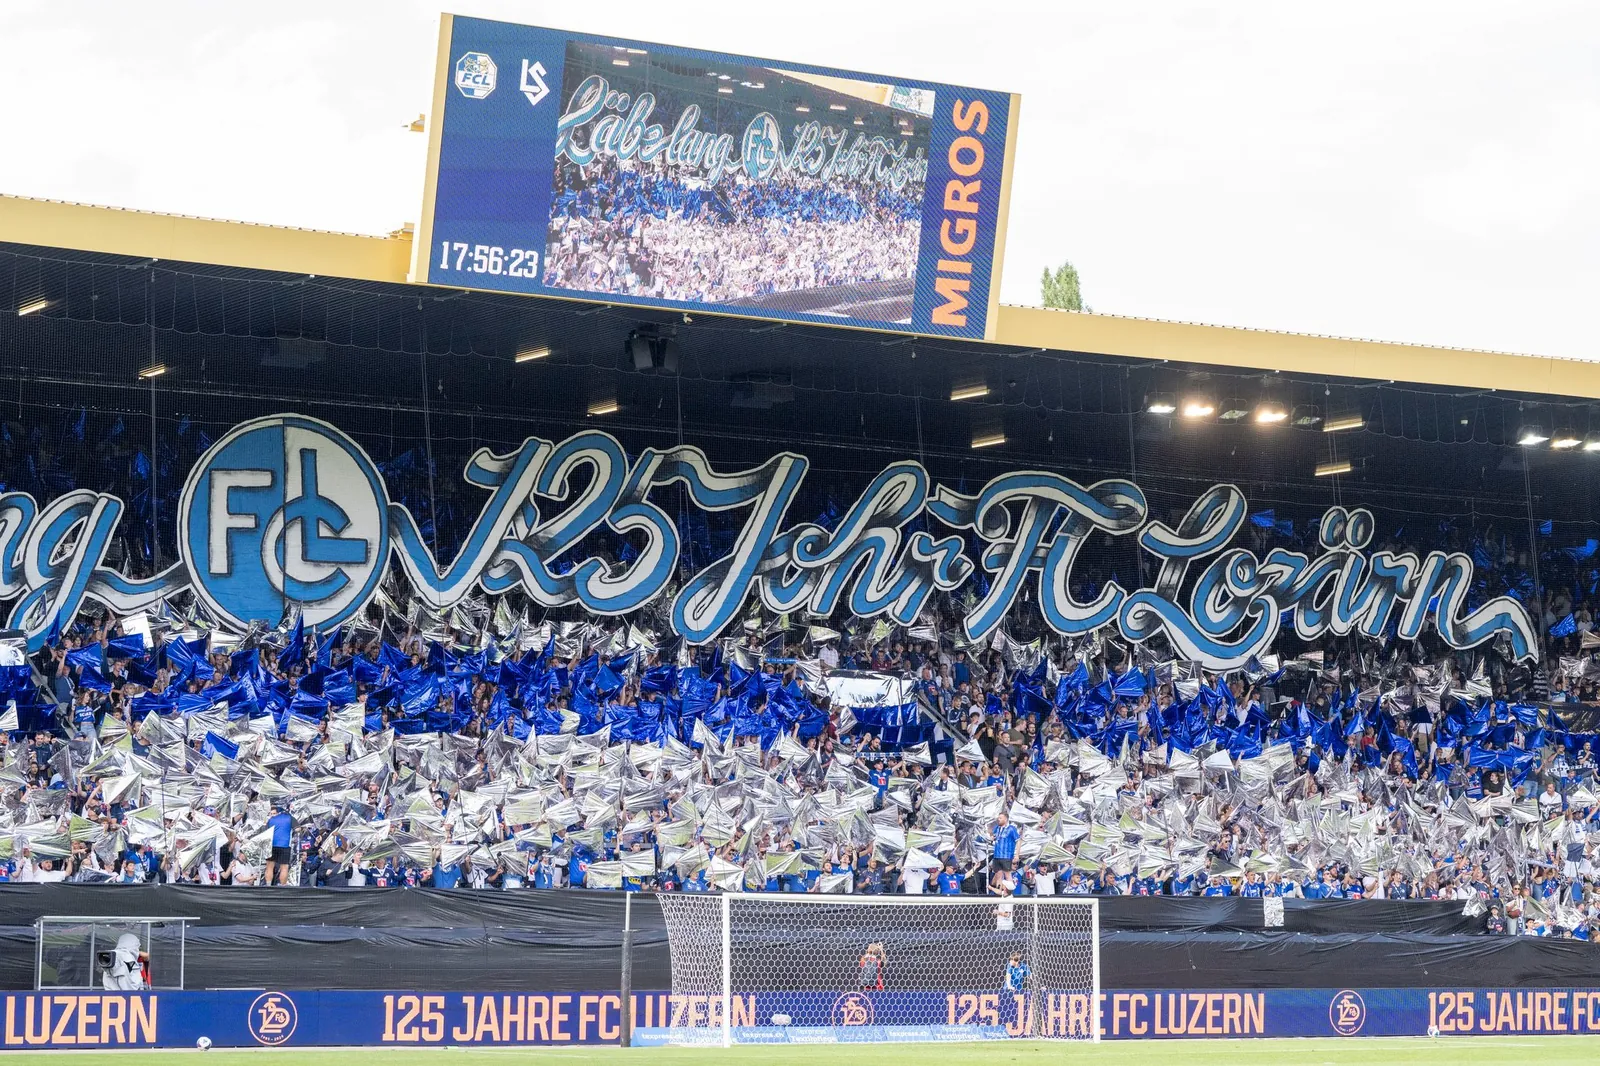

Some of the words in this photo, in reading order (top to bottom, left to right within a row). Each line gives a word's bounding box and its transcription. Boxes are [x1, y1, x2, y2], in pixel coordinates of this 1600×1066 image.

[461, 72, 491, 86] FCL
[931, 98, 990, 327] MIGROS
[440, 241, 539, 278] 17:56:23
[430, 428, 680, 614] 125
[1118, 483, 1539, 674] Lozärn
[5, 995, 158, 1045] LUZERN
[382, 995, 446, 1042] 125
[452, 995, 572, 1042] JAHRE
[578, 995, 621, 1041] FC
[946, 993, 999, 1027] 125
[1004, 993, 1108, 1036] JAHRE
[1112, 993, 1148, 1035] FC
[1154, 993, 1265, 1035] LUZERN
[1428, 991, 1474, 1032] 125
[1479, 991, 1568, 1031] JAHRE
